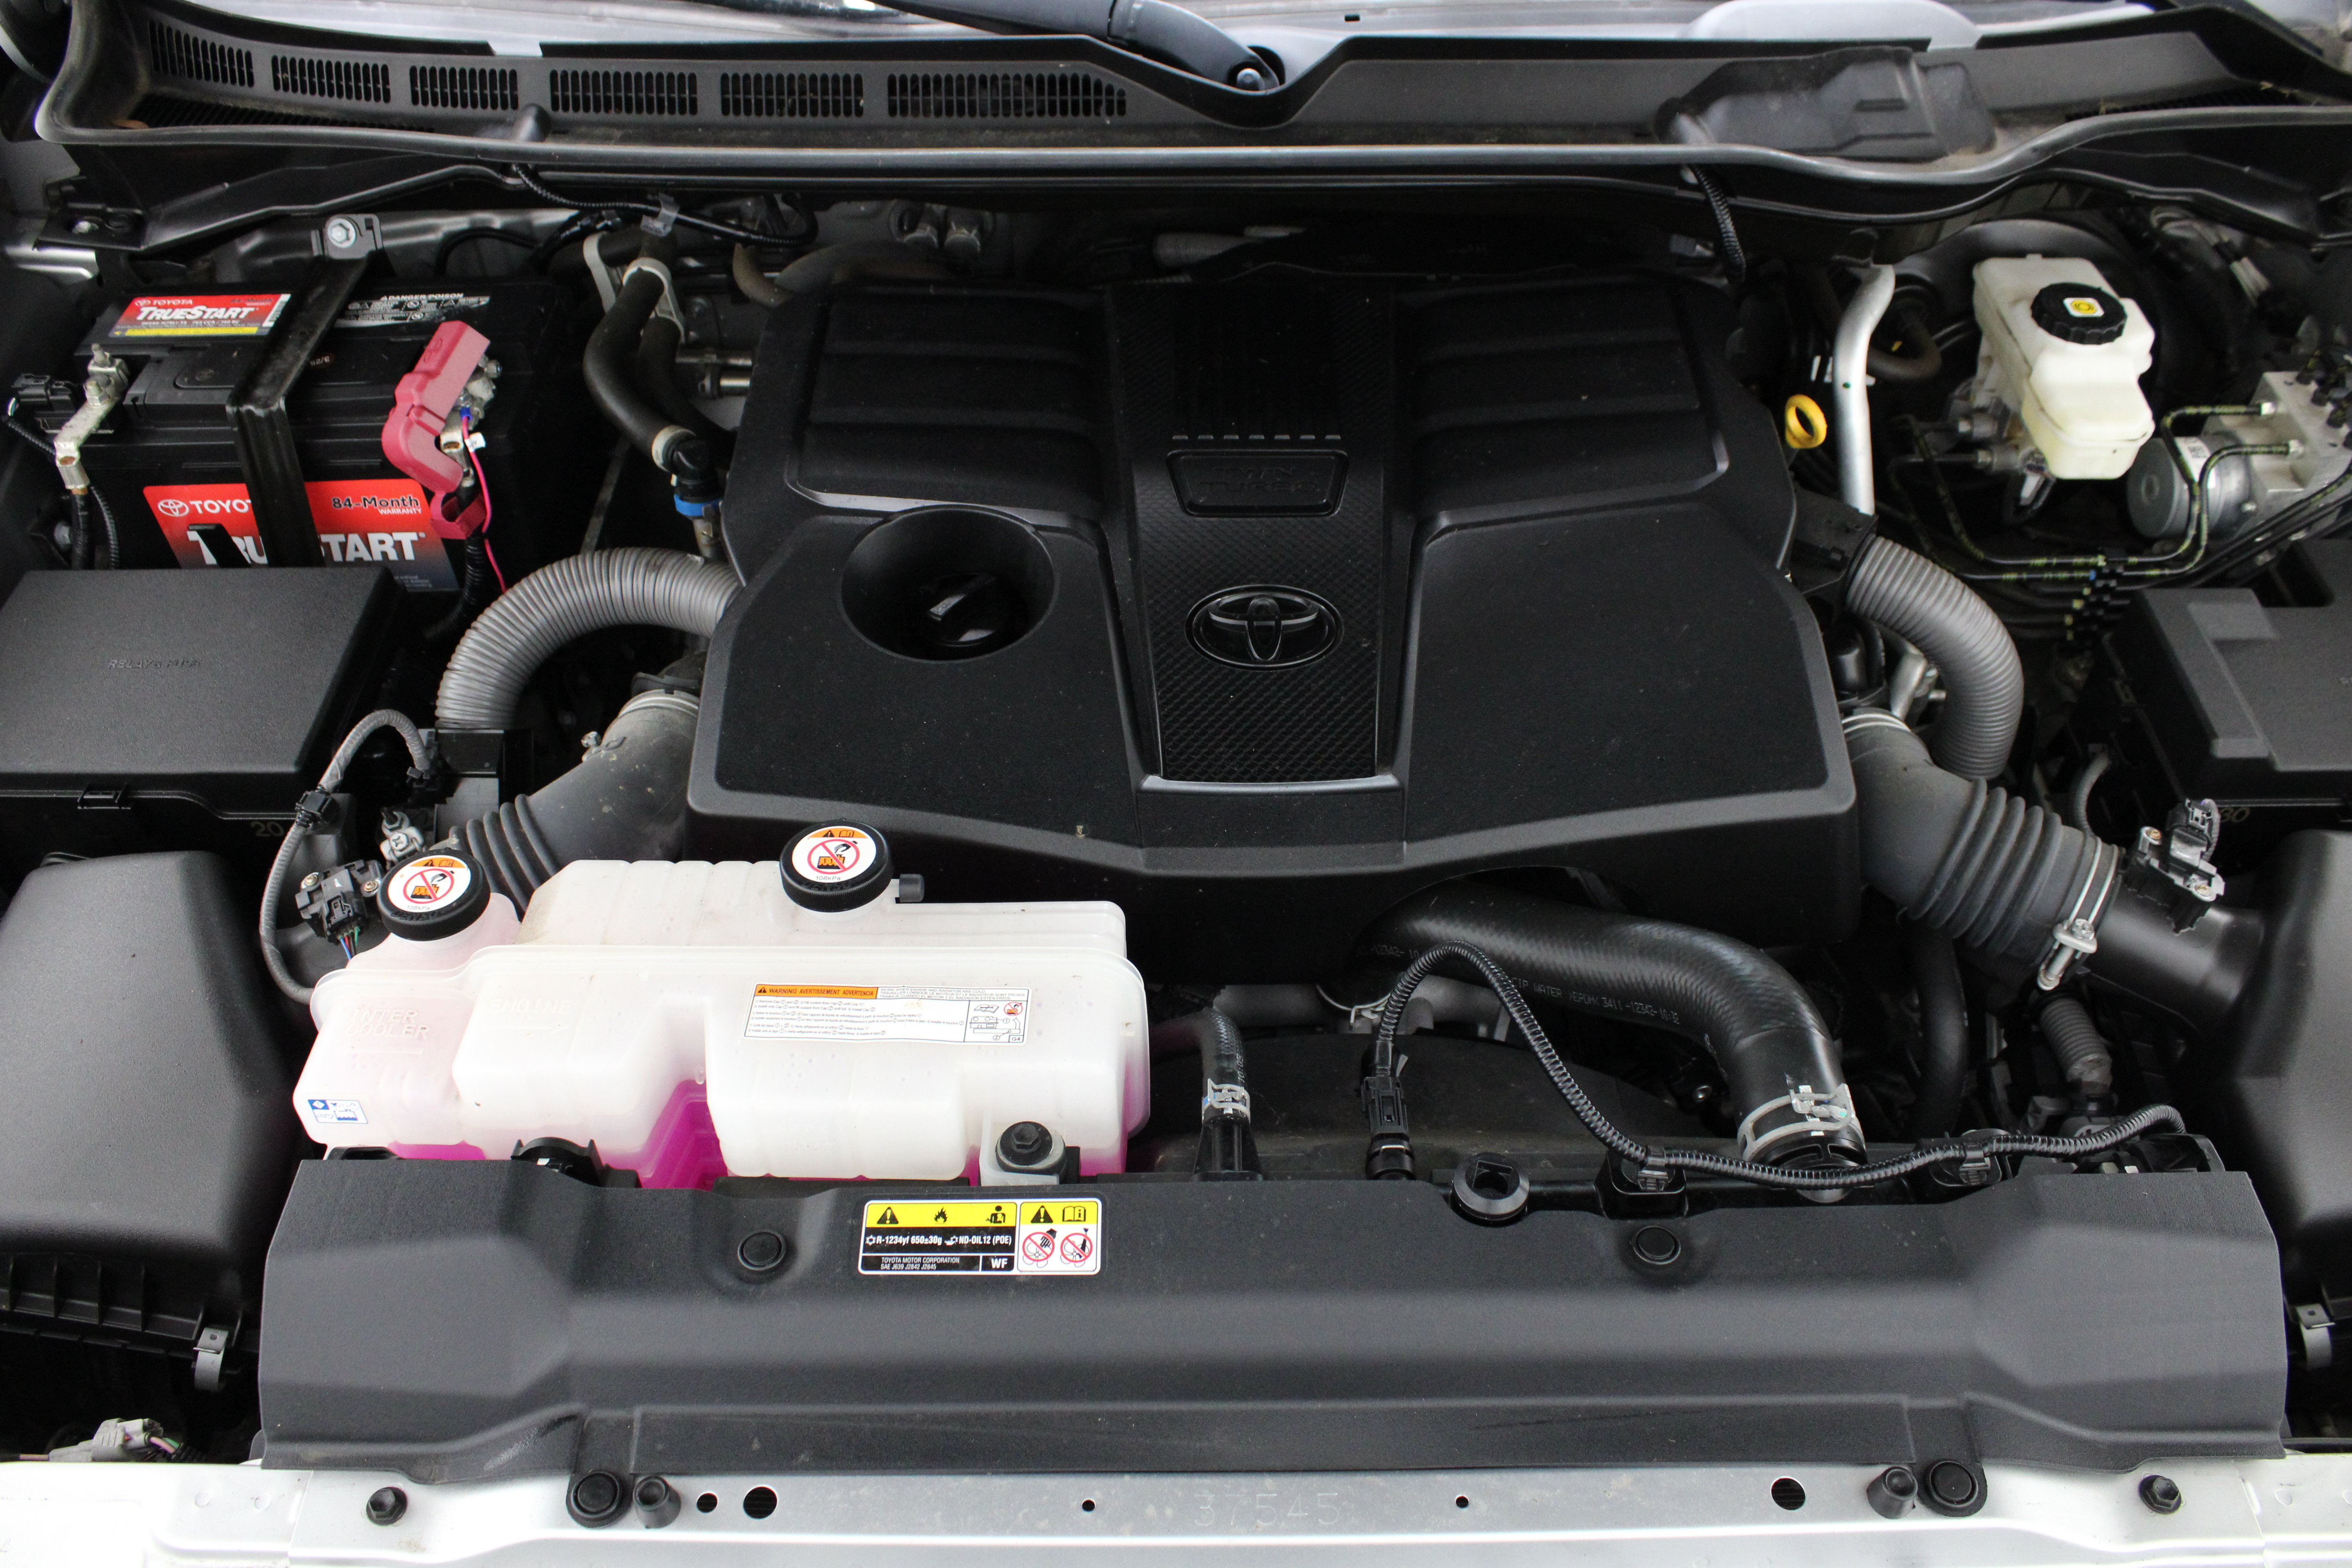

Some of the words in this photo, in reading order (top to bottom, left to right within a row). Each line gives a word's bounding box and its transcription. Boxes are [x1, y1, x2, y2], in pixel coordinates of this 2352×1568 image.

[189, 499, 252, 514] TOYO
[332, 494, 419, 509] 84-Month
[251, 821, 284, 837] 20
[1533, 982, 1562, 998] WATER
[350, 1009, 418, 1024] INTER
[347, 1023, 430, 1040] COOLER
[876, 1236, 910, 1245] R-1234yf
[911, 1236, 942, 1246] 650±30g
[959, 1236, 991, 1244] ND-OIL12
[992, 1236, 1011, 1245] (POE)
[991, 1258, 1008, 1268] WF
[1194, 1492, 1340, 1526] 37545
